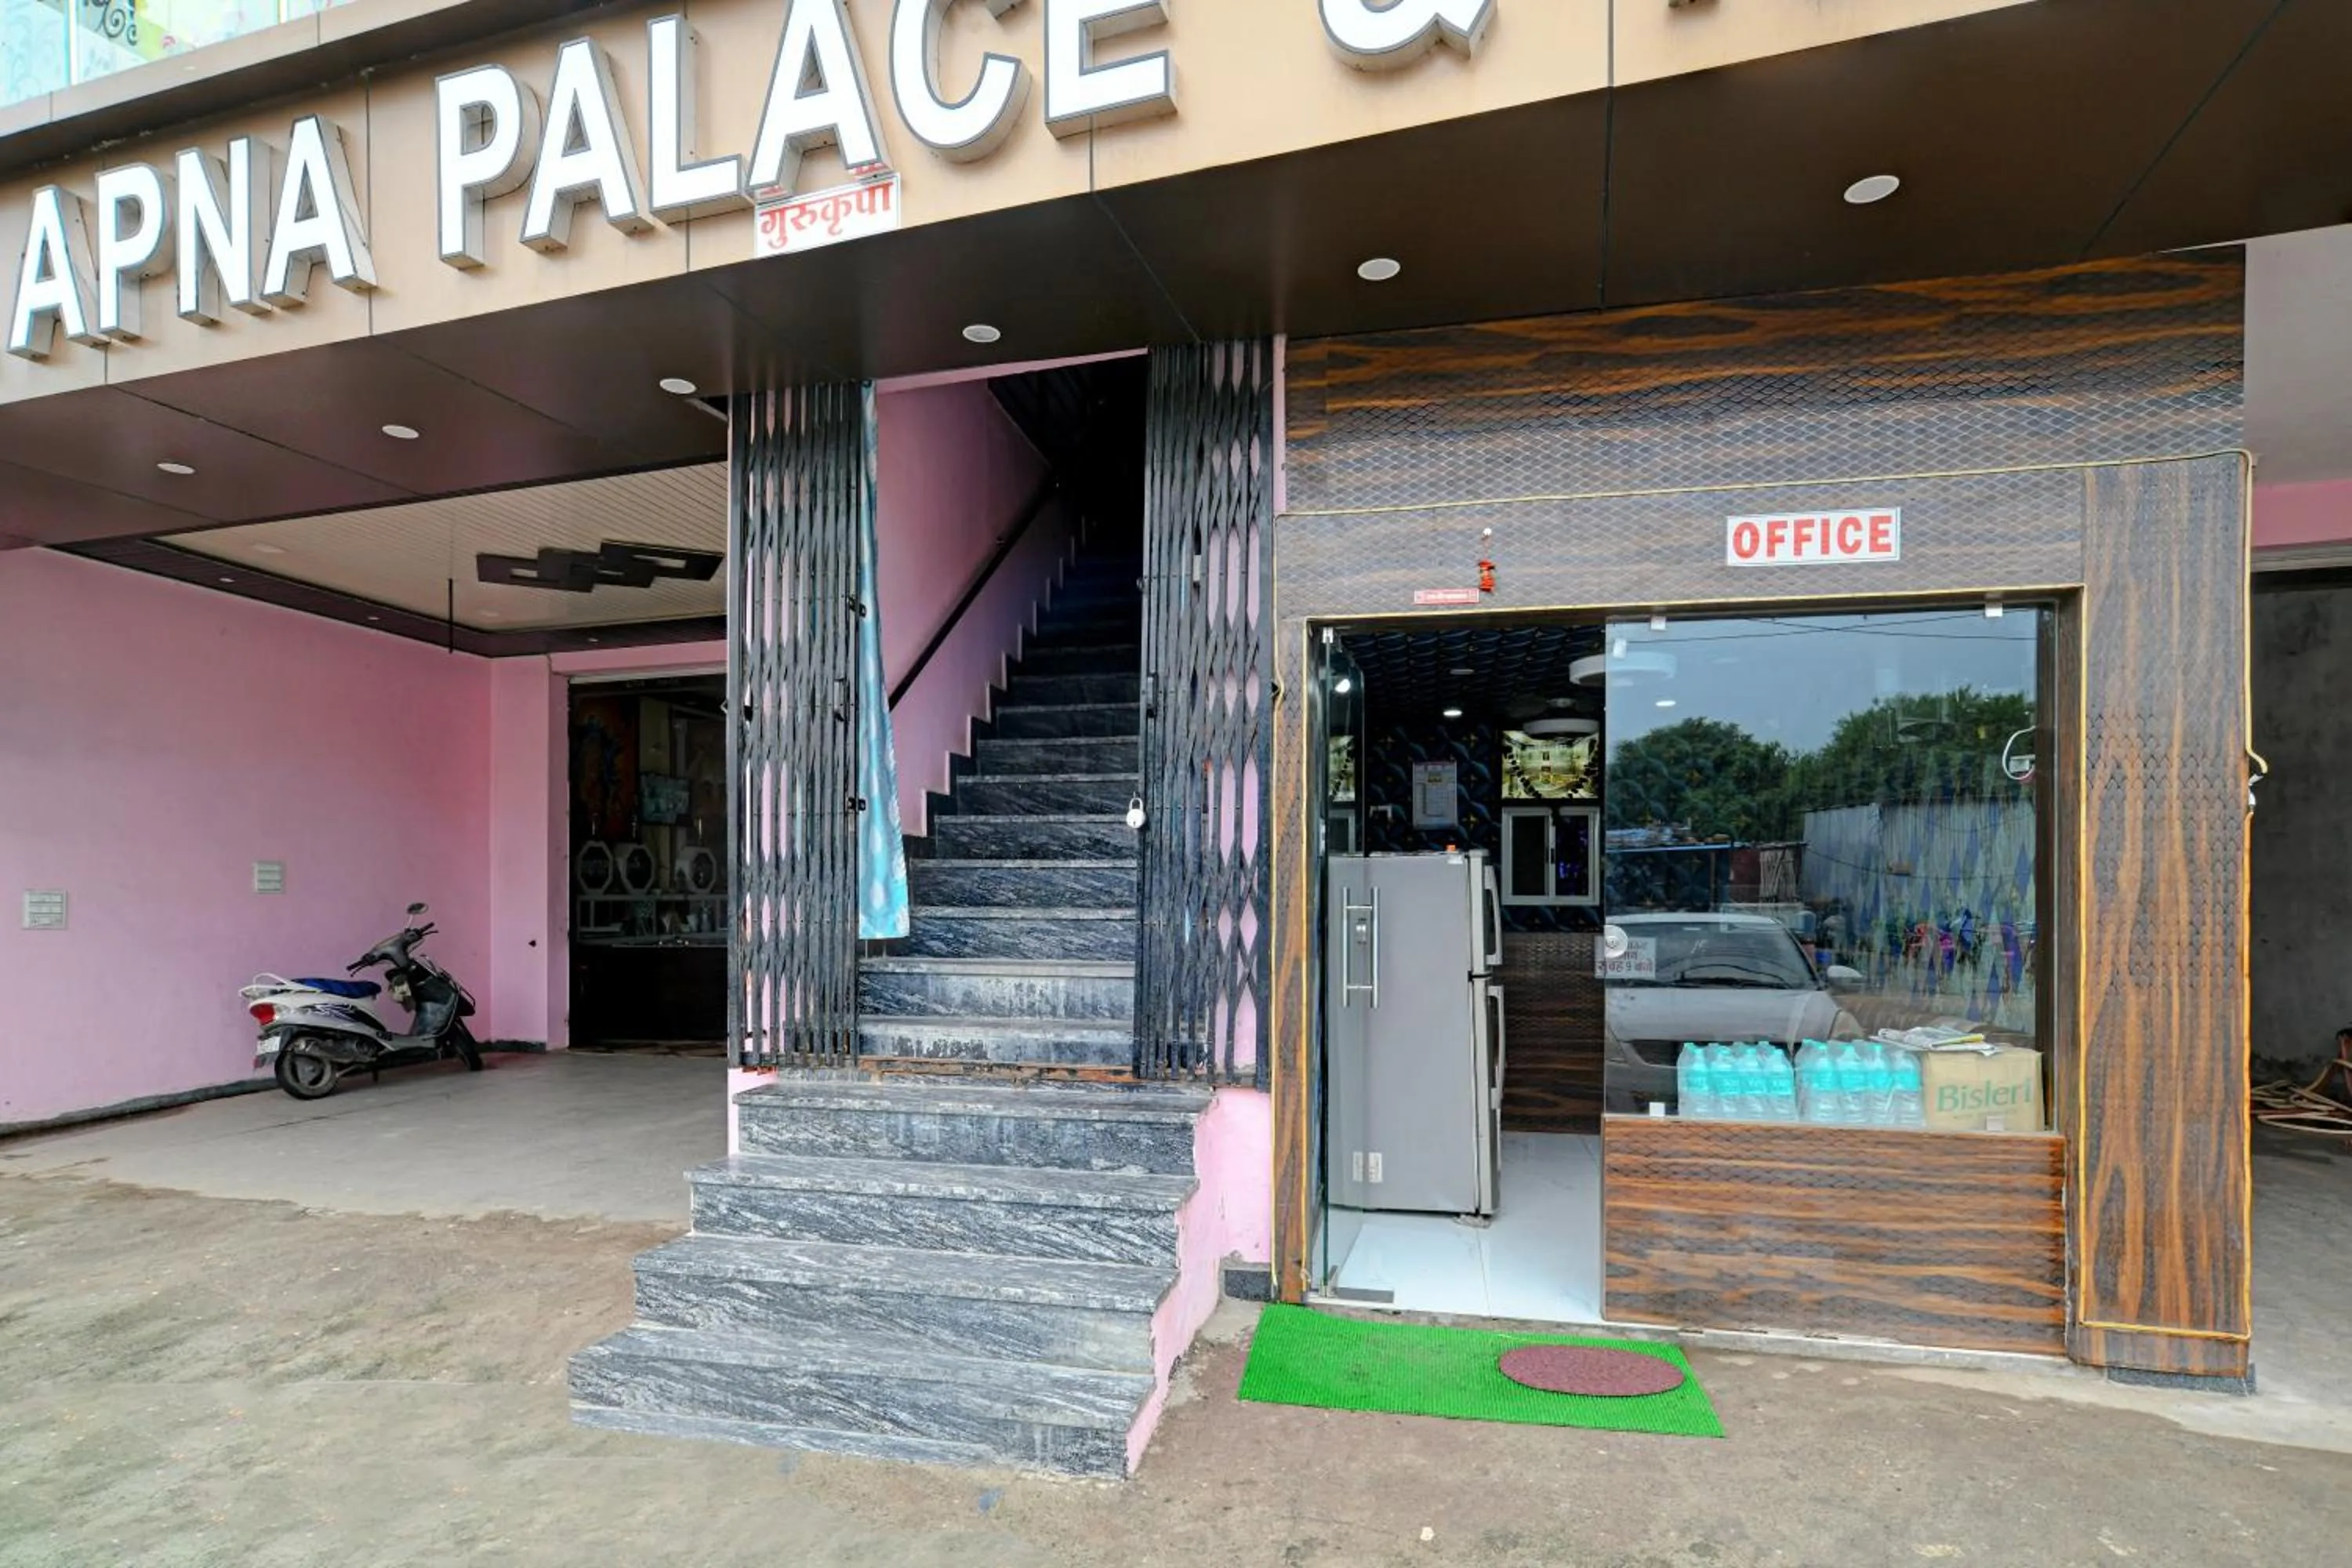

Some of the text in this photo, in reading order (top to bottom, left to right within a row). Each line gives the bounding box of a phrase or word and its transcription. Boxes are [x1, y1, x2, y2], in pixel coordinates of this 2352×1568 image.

[6, 113, 376, 359] APNA
[759, 181, 895, 249] गुरुकृपा
[1733, 515, 1892, 559] OFFICE
[1936, 1077, 2031, 1112] Bisleri
